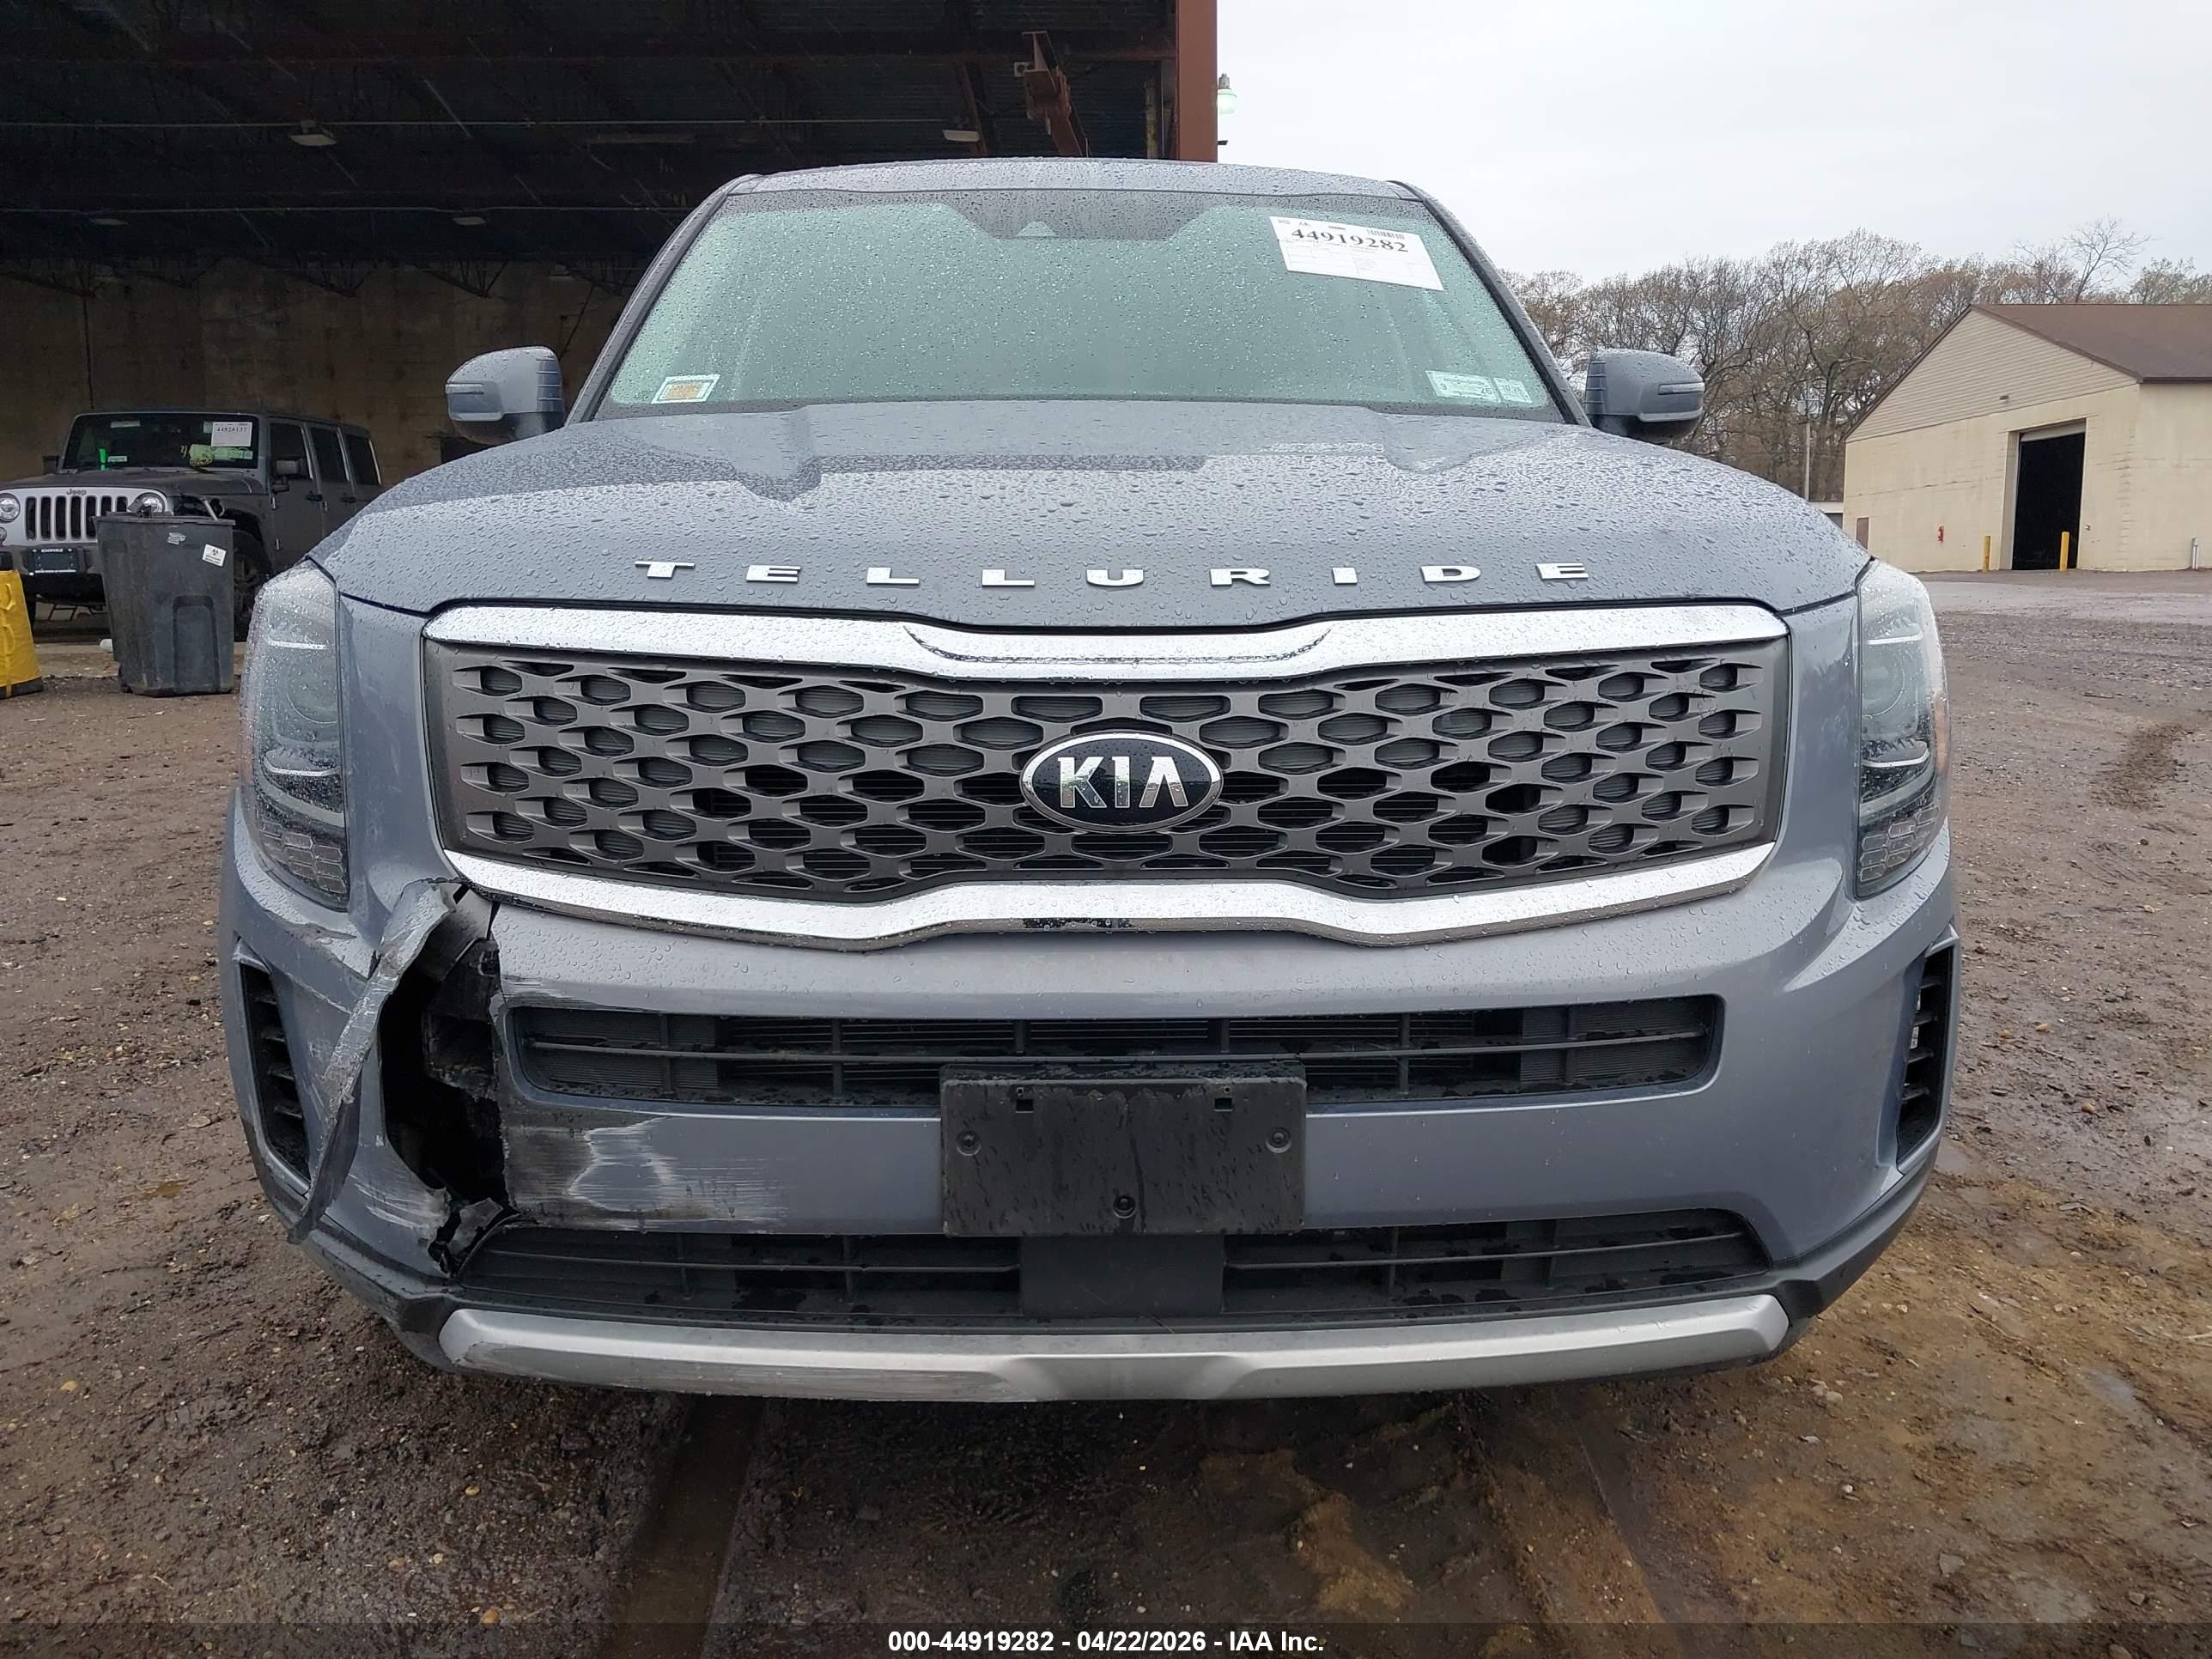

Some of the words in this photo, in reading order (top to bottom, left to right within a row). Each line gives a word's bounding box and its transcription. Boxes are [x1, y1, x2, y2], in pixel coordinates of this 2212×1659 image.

[1291, 229, 1408, 252] 44919282
[635, 560, 1589, 586] TELLURIDE
[1058, 757, 1188, 808] KIA
